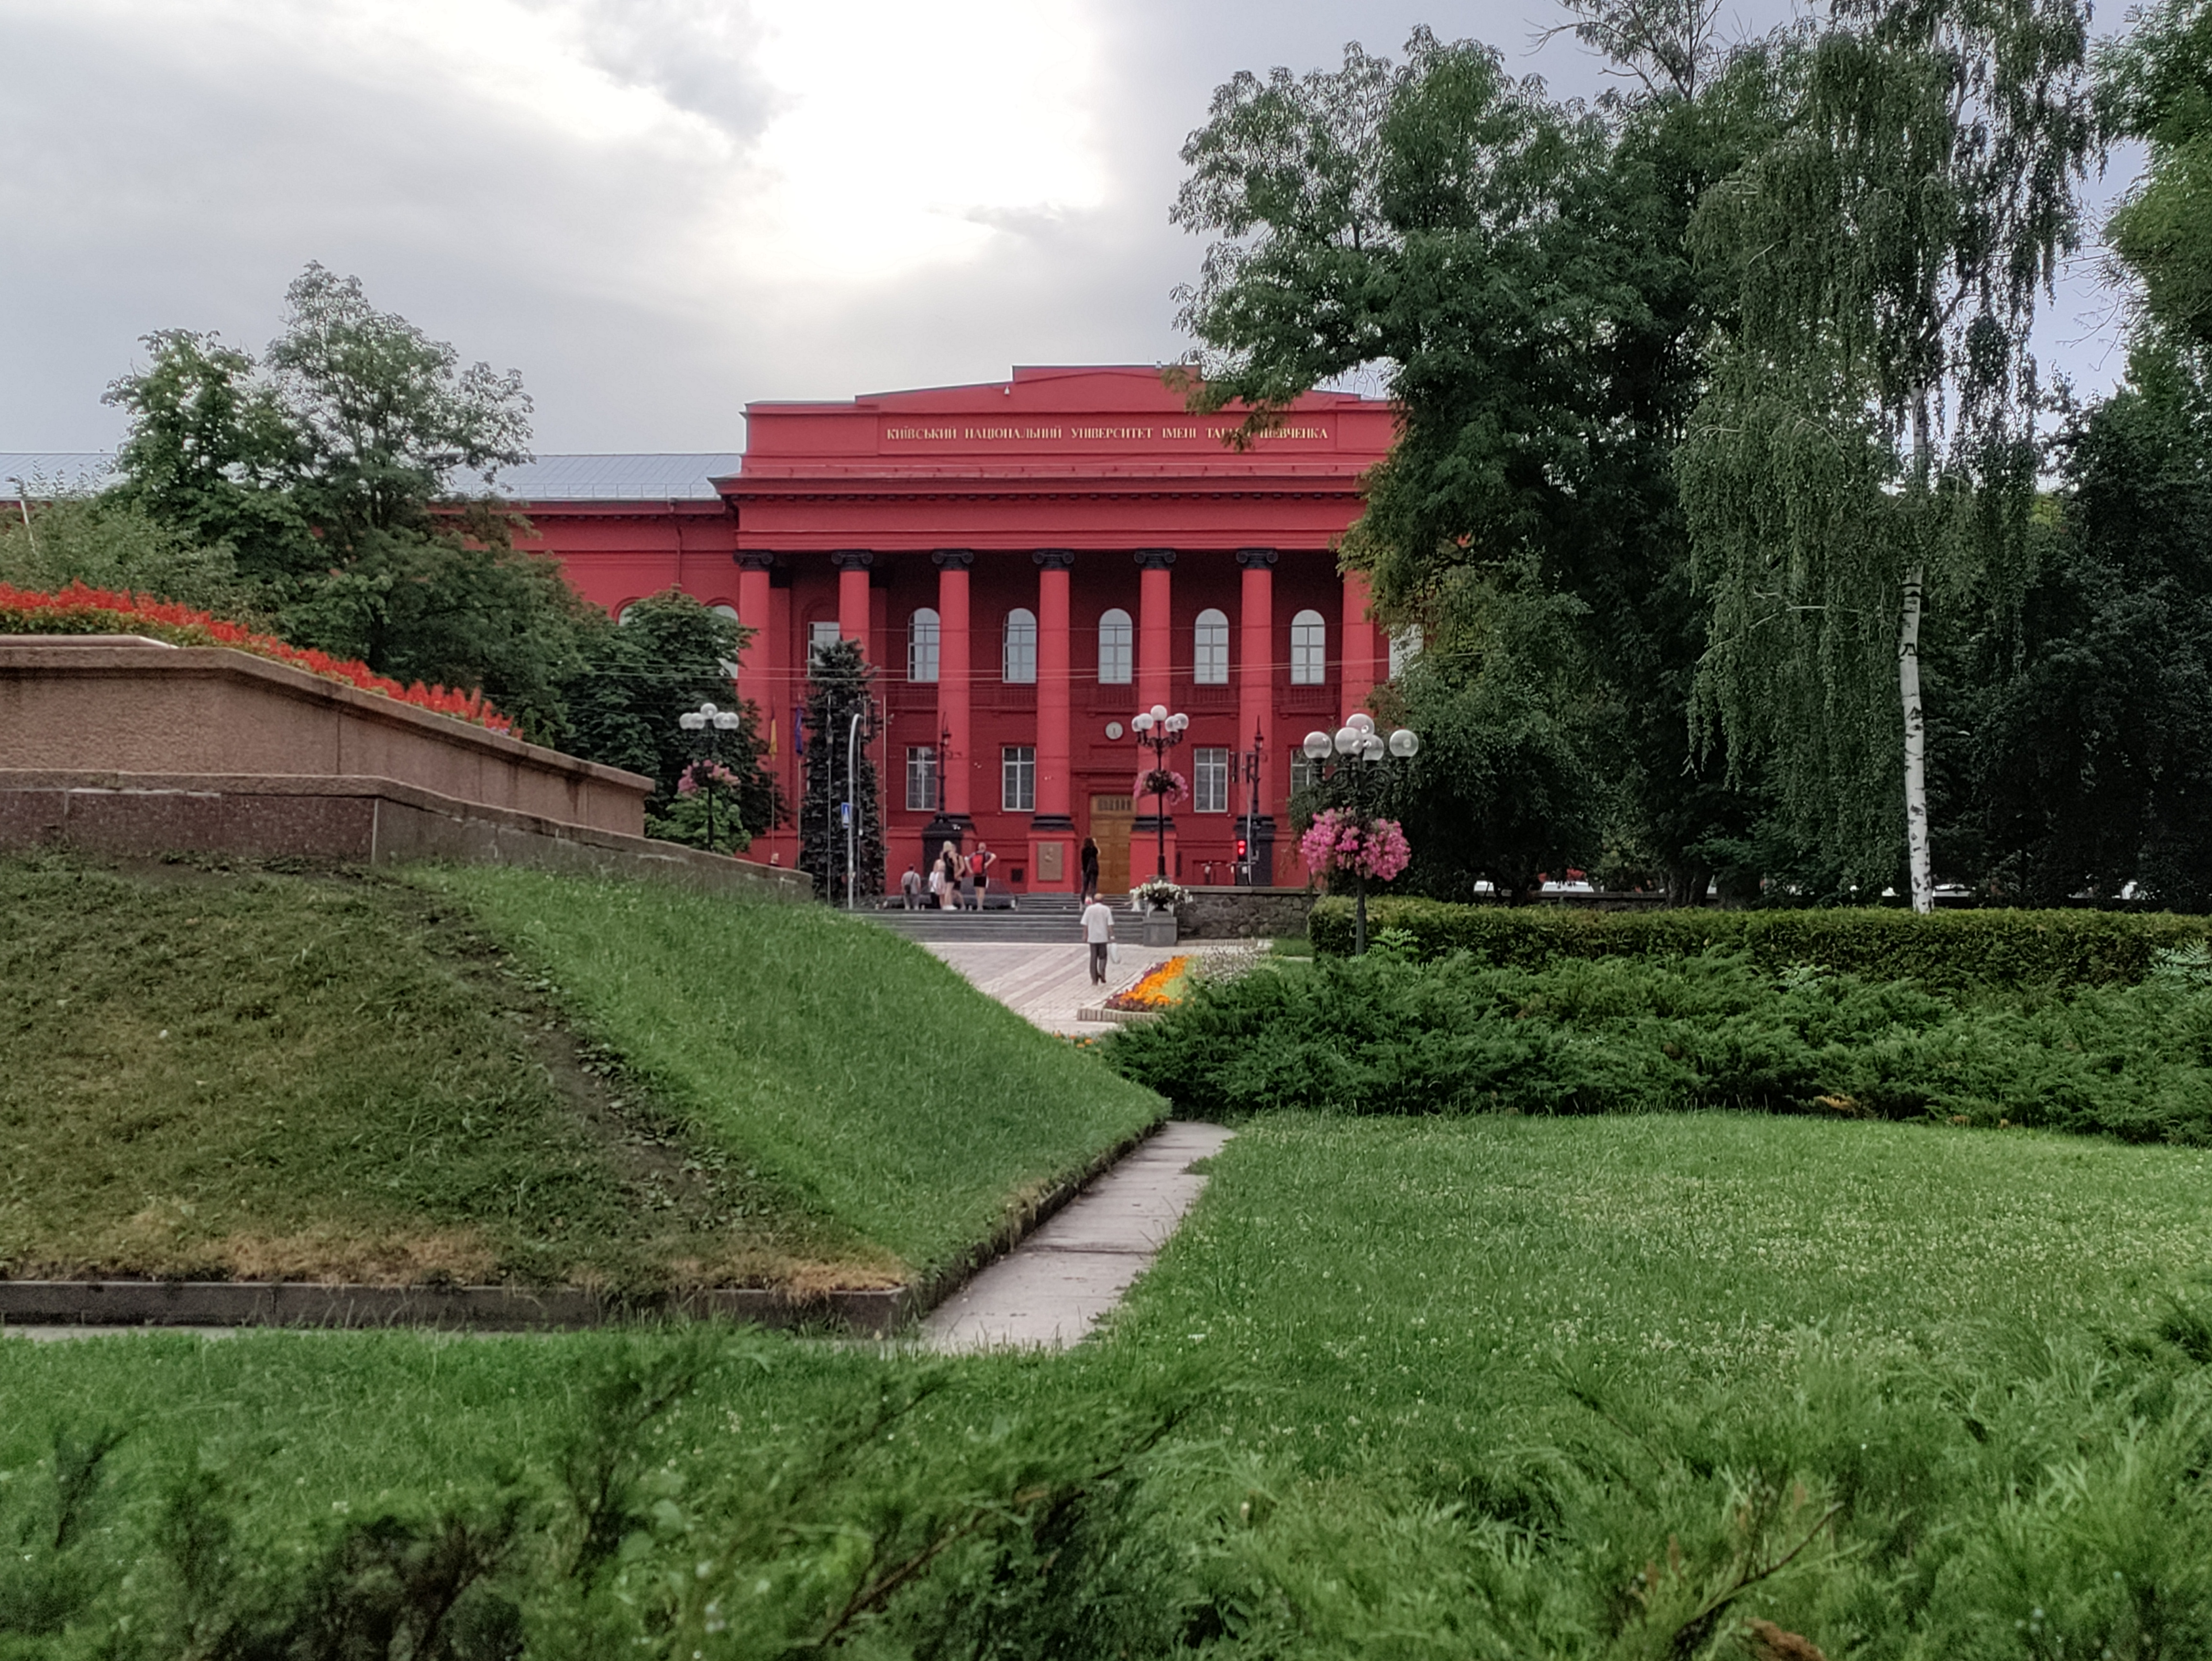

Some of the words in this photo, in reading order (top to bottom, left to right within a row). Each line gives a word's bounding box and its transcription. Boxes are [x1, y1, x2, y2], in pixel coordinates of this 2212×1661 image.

[887, 426, 956, 439] КИЇВСЬКИЙ
[964, 425, 1062, 439] НАЦІОНАЛЬНИЙ
[1071, 428, 1153, 439] УНІВЕРСИТЕТ
[1162, 428, 1196, 439] ІМЕНІ
